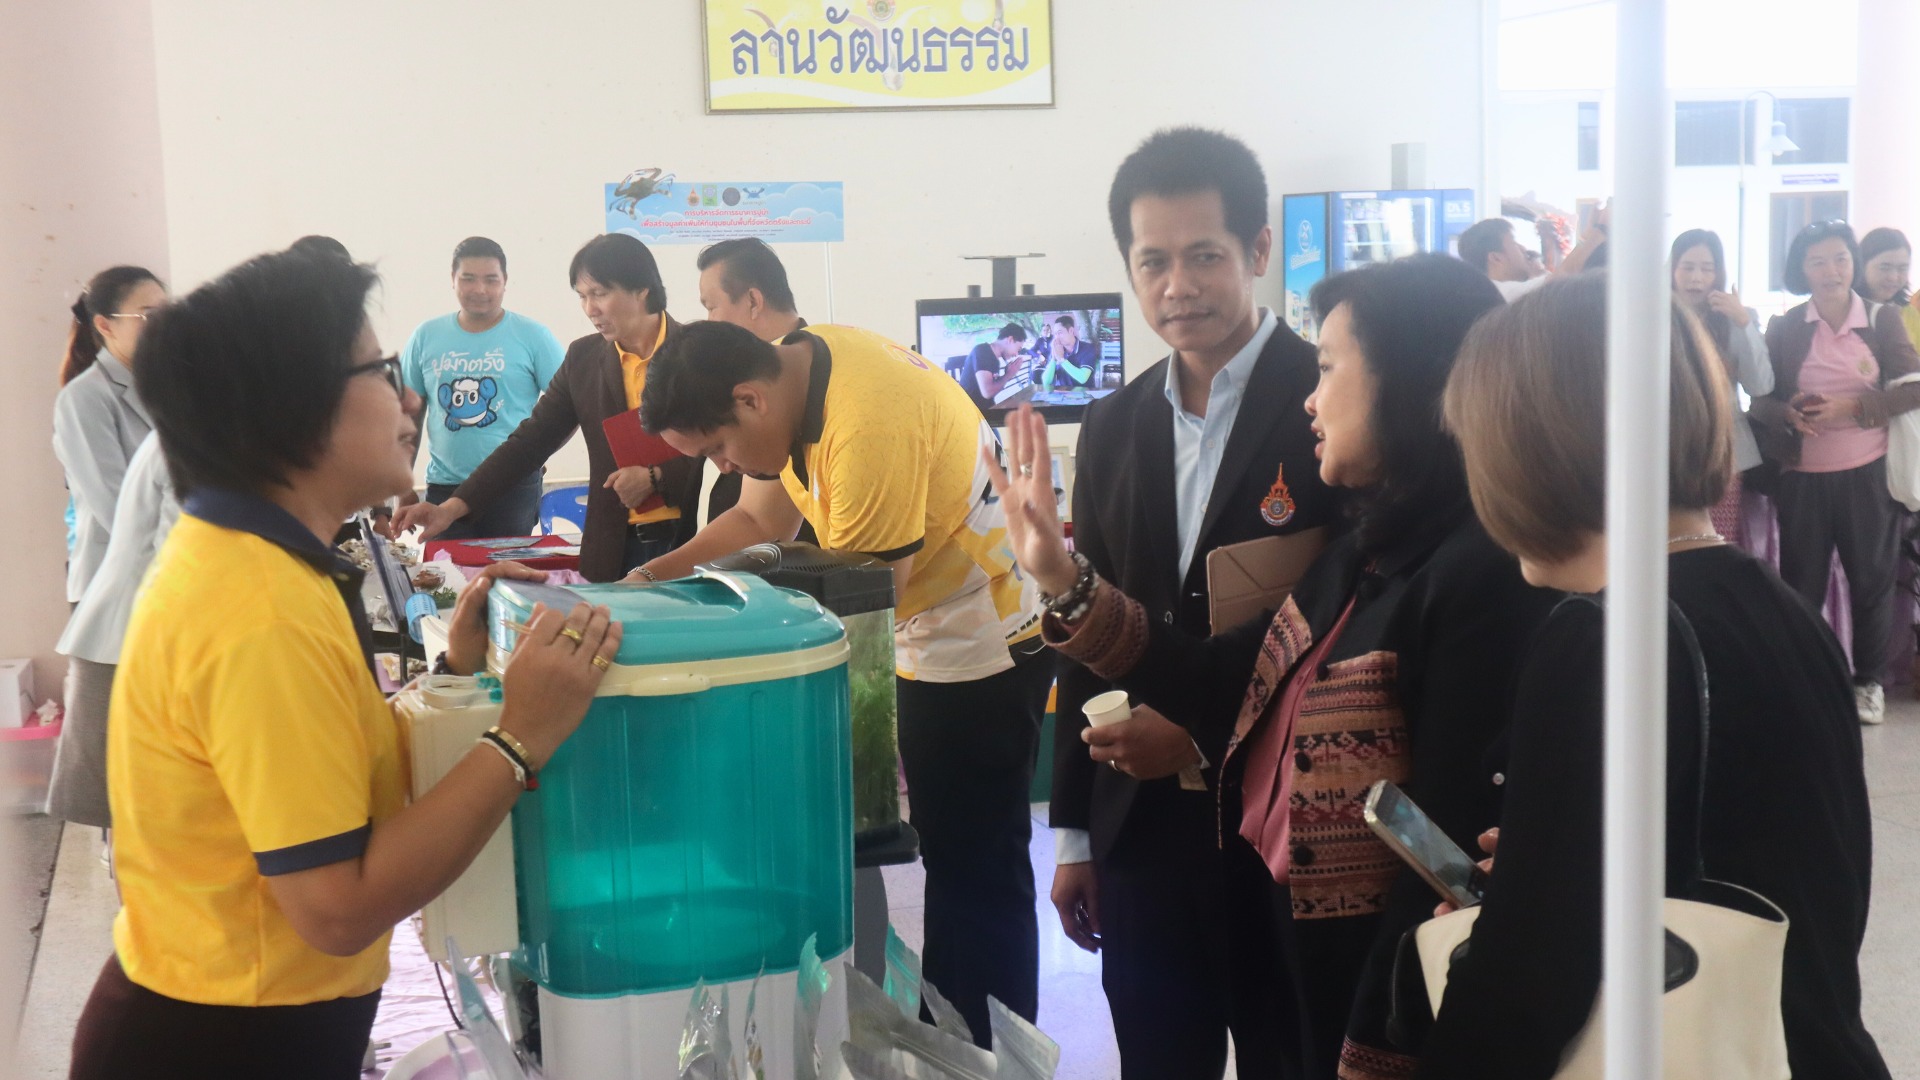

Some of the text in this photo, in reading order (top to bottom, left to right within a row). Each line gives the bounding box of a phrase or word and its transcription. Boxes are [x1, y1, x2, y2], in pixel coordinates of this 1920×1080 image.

[730, 6, 1030, 75] ลานวัฒนธรรม
